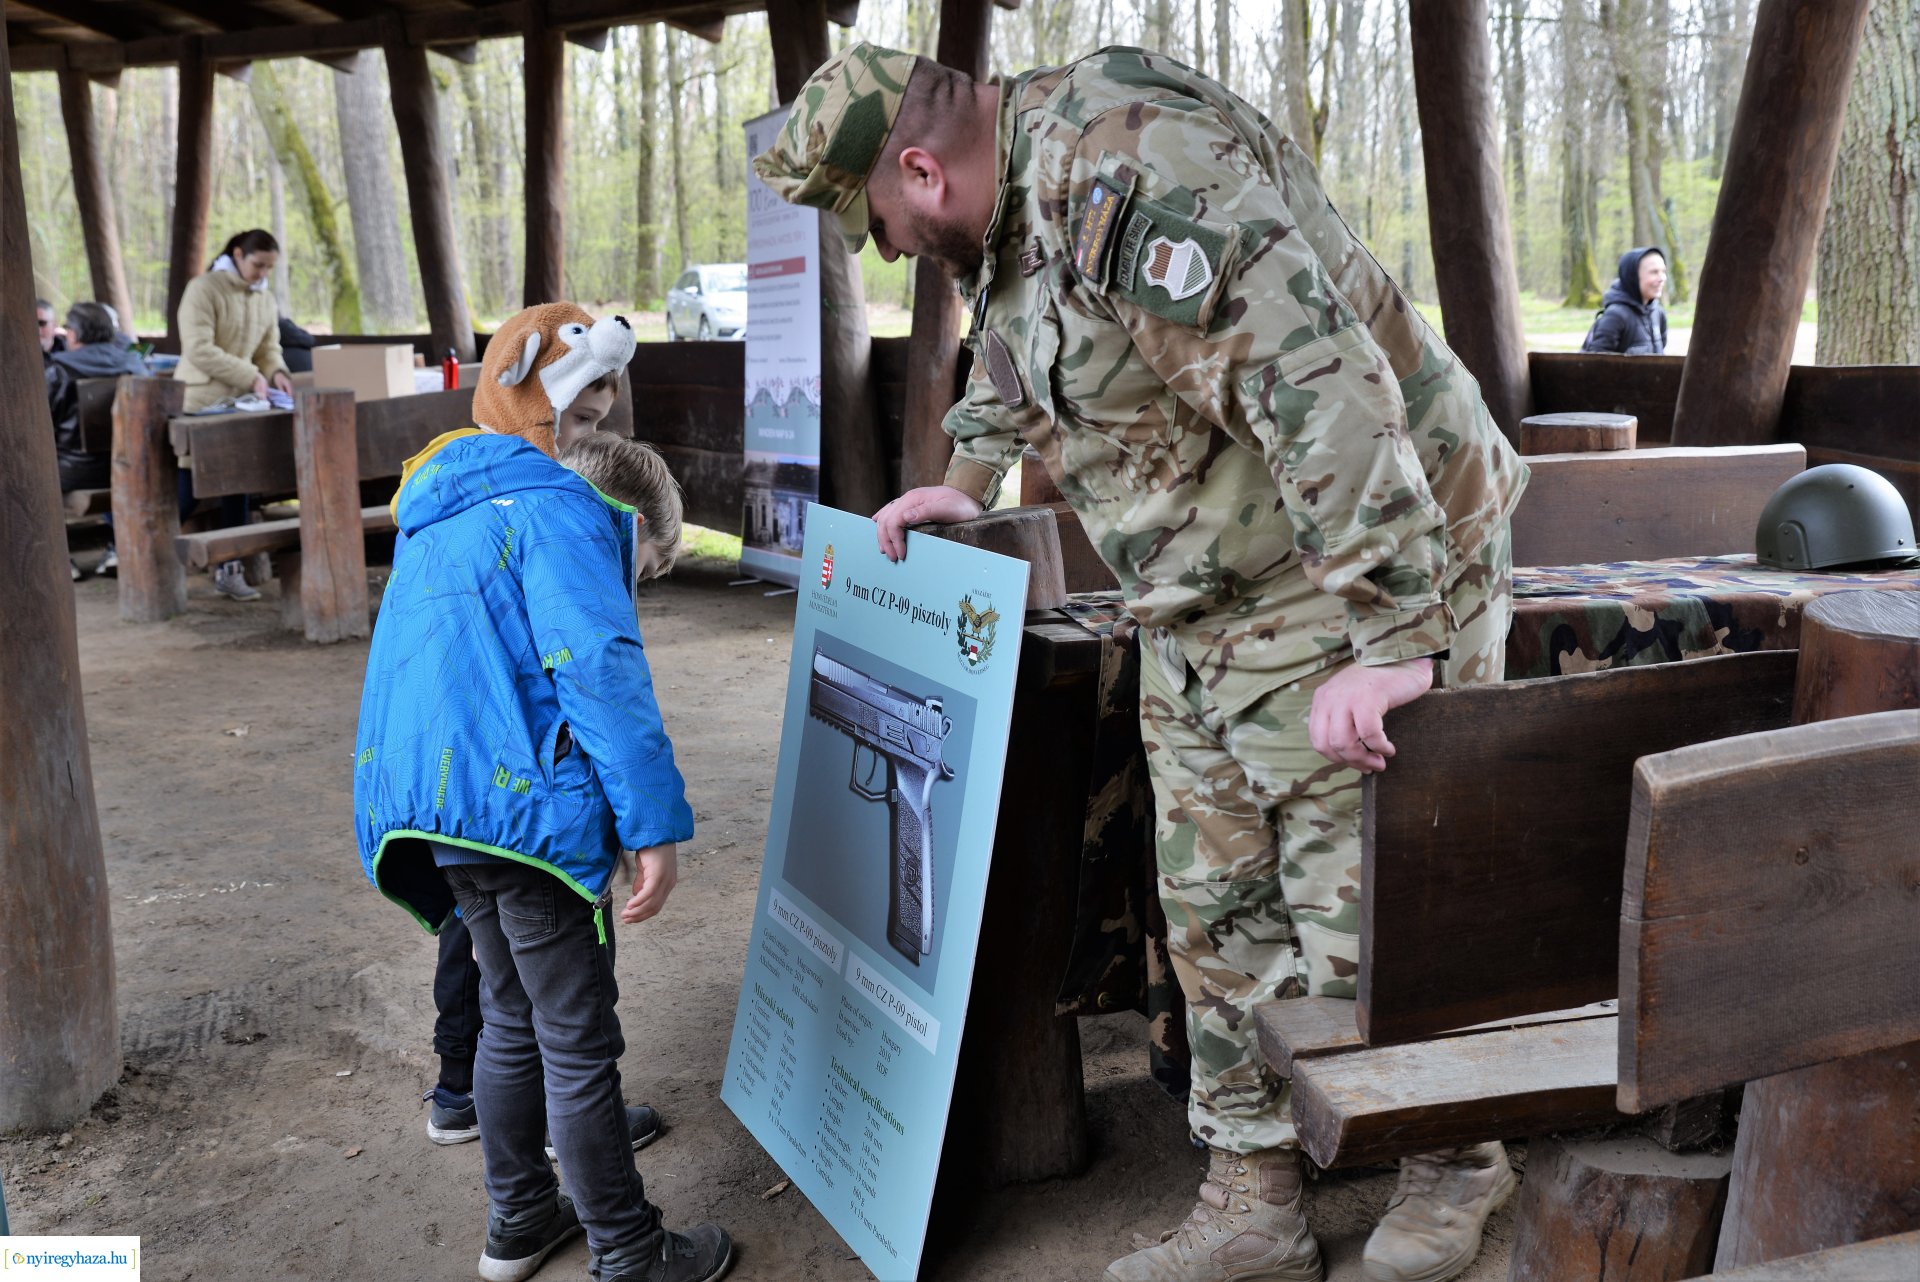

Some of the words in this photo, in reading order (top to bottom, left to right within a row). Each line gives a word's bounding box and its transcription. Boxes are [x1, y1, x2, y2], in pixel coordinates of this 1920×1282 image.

[846, 576, 851, 593] 9
[852, 583, 868, 600] mm
[871, 587, 886, 608] CZ
[888, 592, 910, 616] P-09
[911, 606, 952, 636] pisztoly
[435, 747, 454, 811] EVERYWHERE
[510, 775, 533, 795] WE
[773, 898, 778, 910] 9
[778, 906, 788, 921] mm
[790, 913, 799, 929] CZ
[800, 920, 813, 940] P-09
[813, 934, 837, 964] pisztoly
[855, 967, 861, 980] 9
[861, 976, 874, 993] mm
[876, 985, 887, 1003] CZ
[888, 994, 905, 1016] P-09
[906, 1012, 927, 1036] pistol
[831, 1056, 859, 1092] Technical
[860, 1088, 903, 1135] specifications
